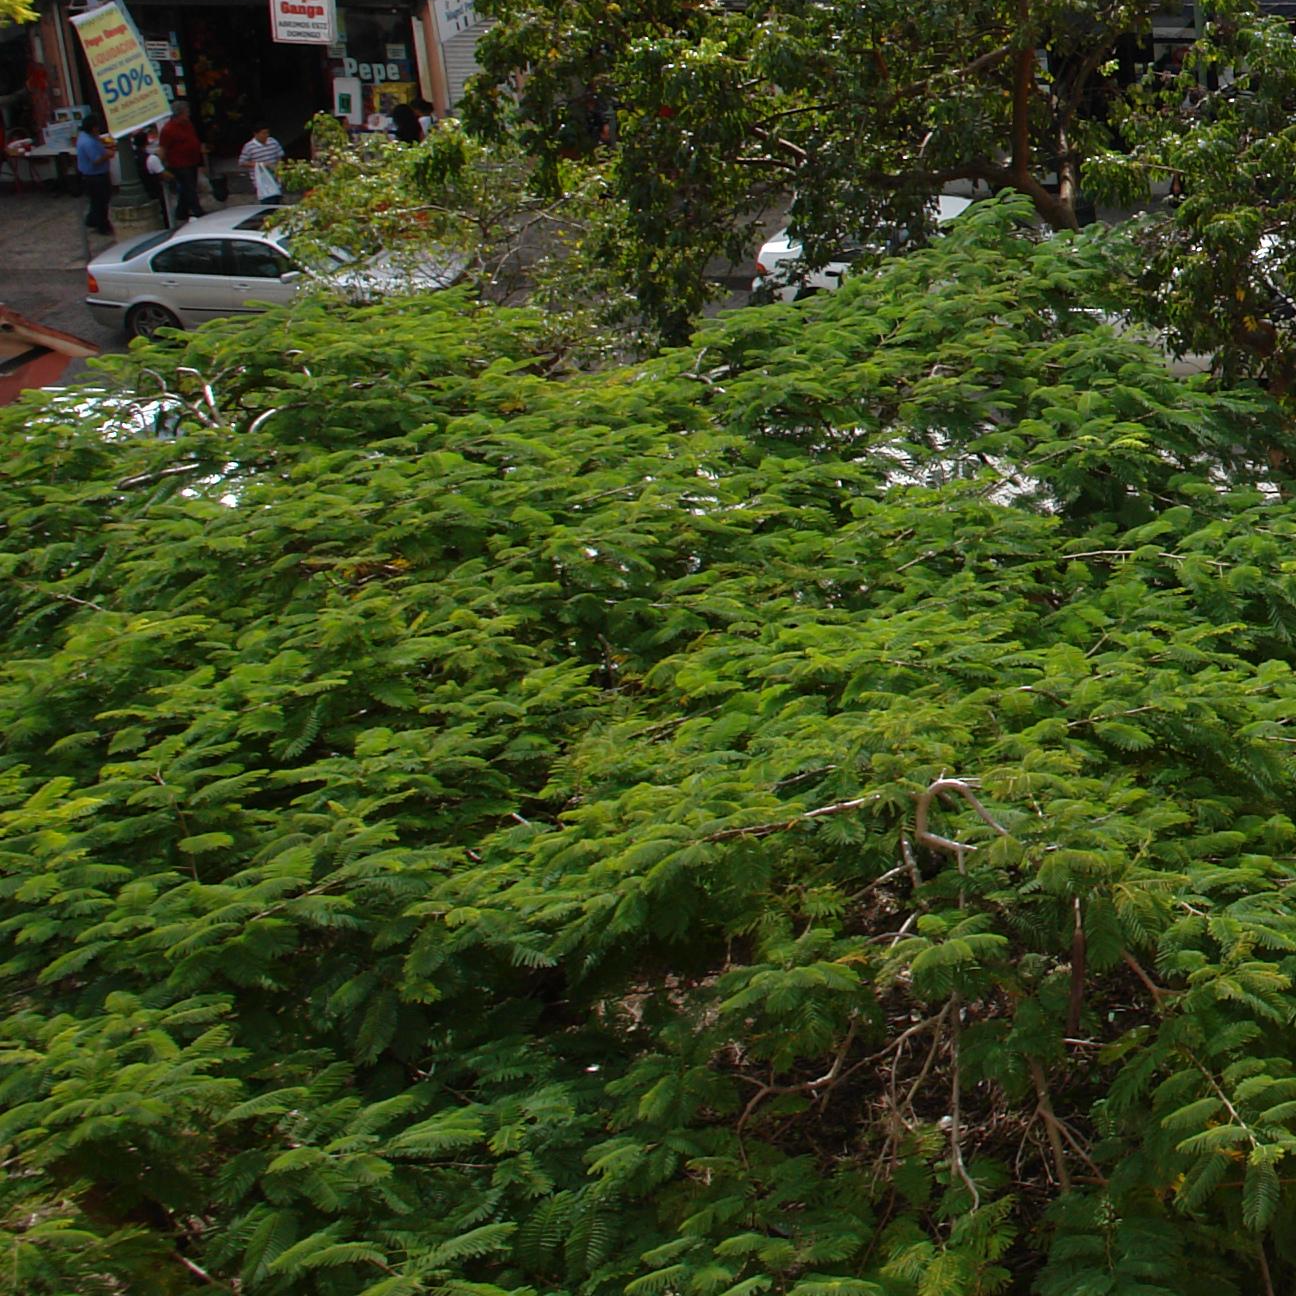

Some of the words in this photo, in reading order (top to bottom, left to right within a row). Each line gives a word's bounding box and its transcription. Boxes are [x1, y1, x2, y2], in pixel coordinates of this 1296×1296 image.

[280, 1, 325, 19] Ganga
[101, 63, 154, 104] 50%
[342, 57, 400, 85] Pepe
